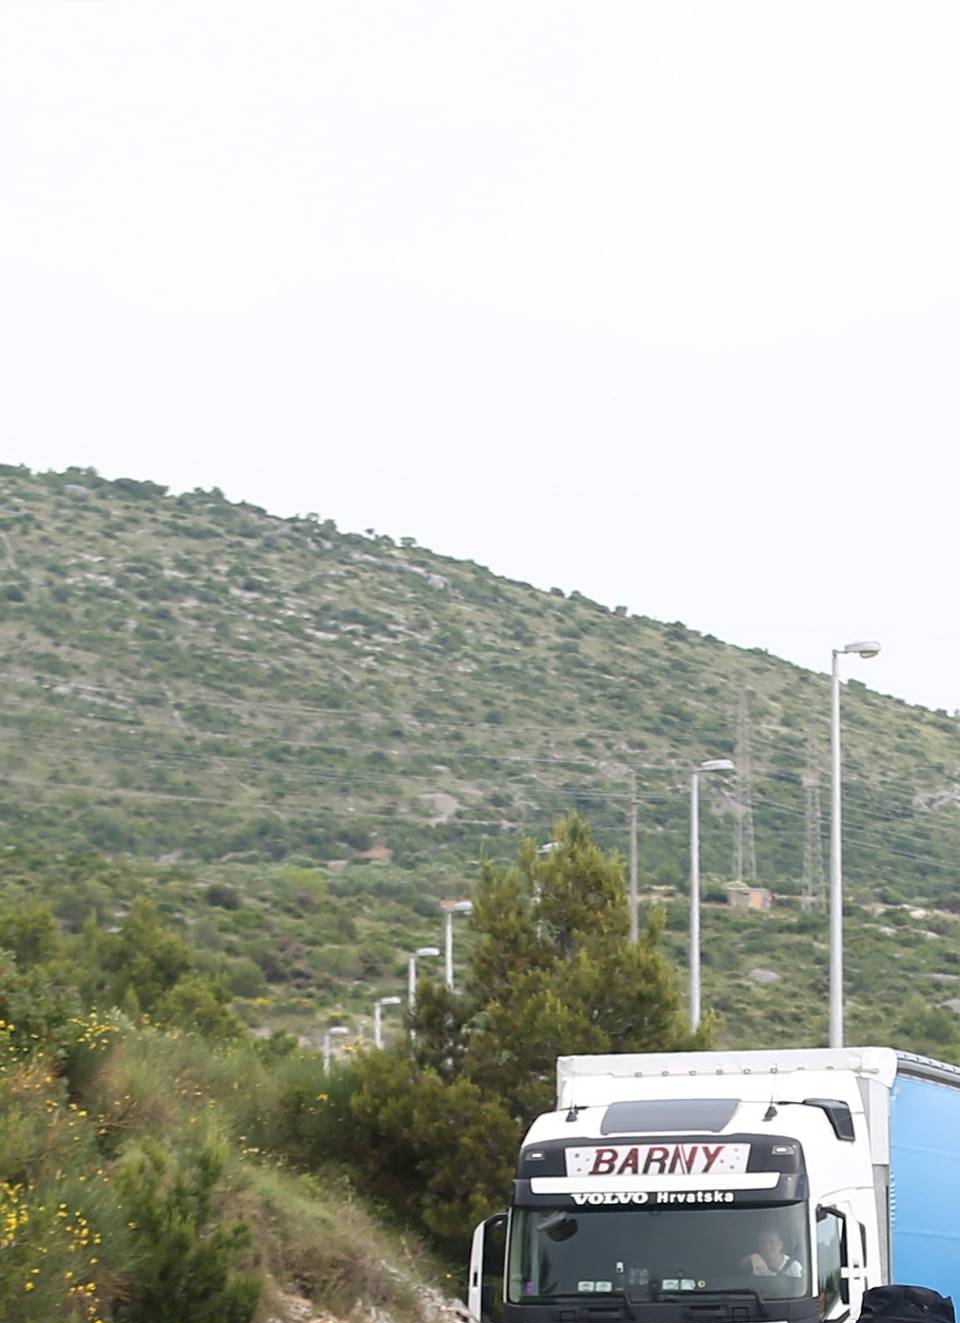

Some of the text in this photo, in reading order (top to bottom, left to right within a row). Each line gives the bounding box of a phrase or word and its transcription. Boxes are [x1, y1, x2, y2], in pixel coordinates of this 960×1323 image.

[588, 1144, 726, 1177] BARNY
[571, 1190, 734, 1206] VOLVO Hrvatska
